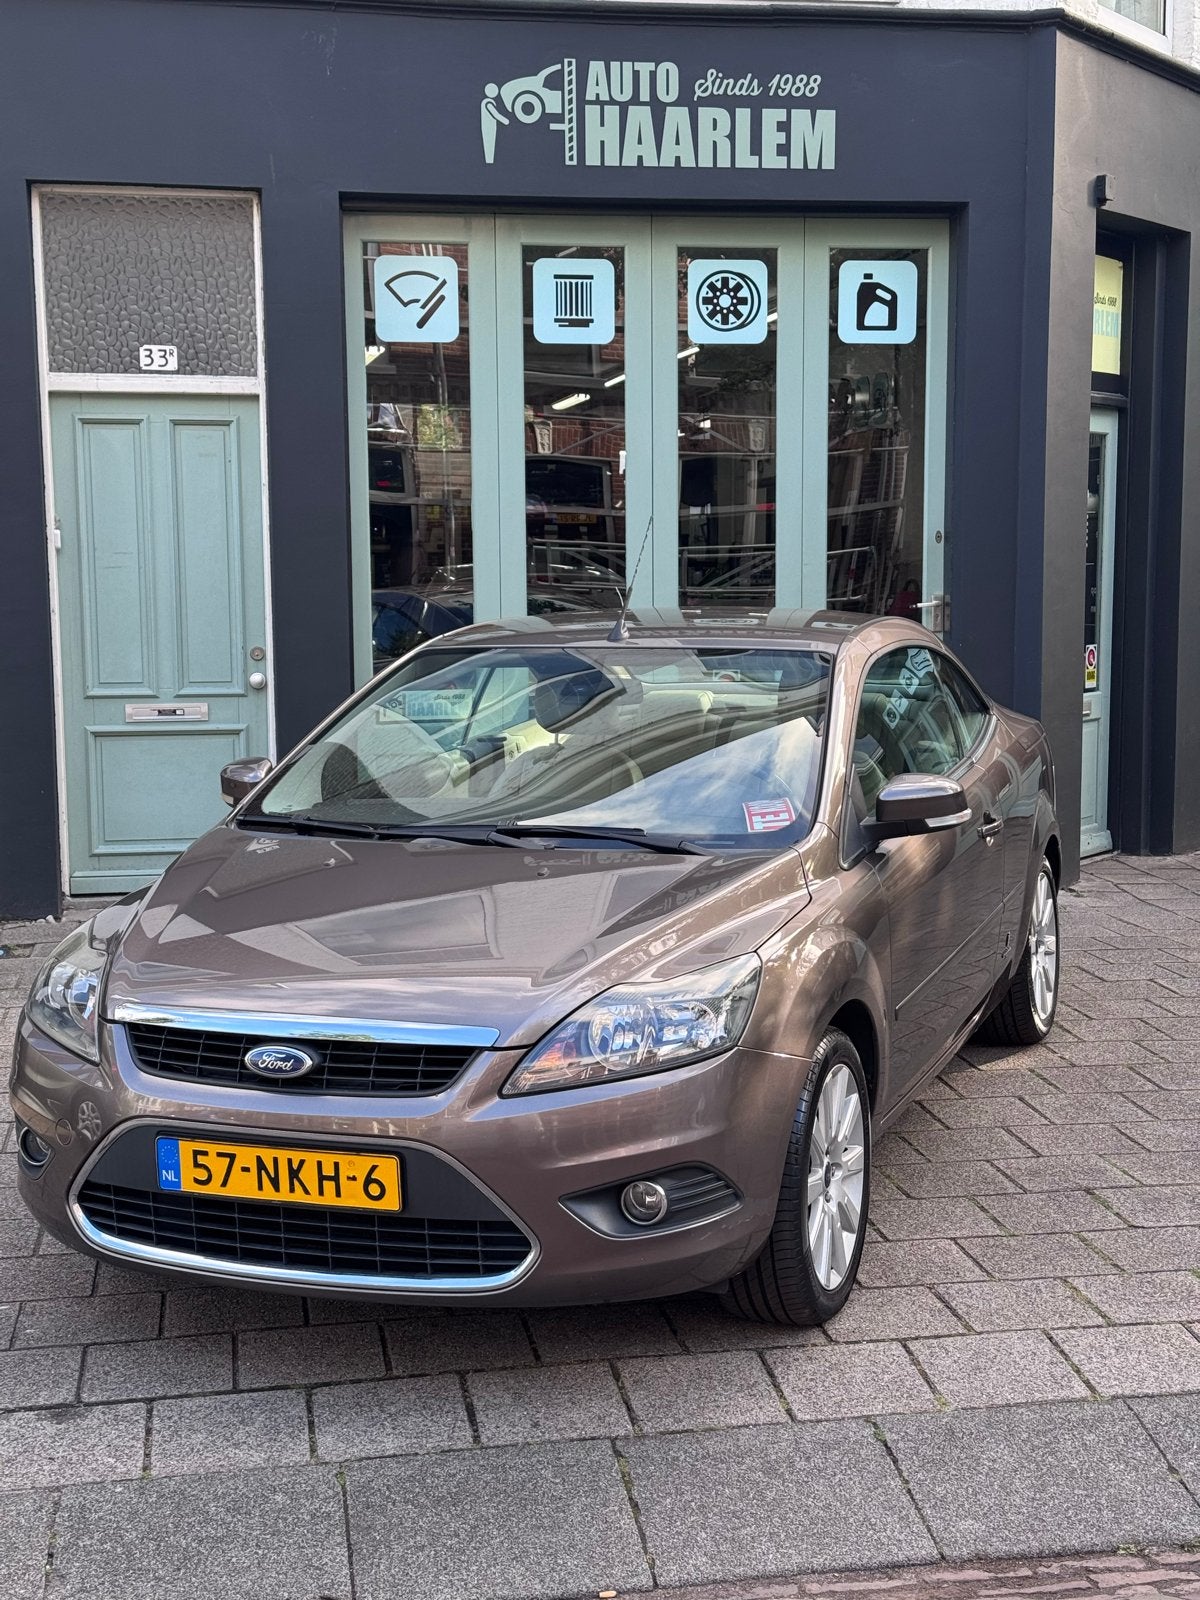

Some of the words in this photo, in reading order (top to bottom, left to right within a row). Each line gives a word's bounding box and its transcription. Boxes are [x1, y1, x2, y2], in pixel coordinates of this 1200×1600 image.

[585, 60, 679, 103] AUTO
[693, 68, 764, 102] Sinds
[768, 73, 822, 98] 1988
[584, 104, 836, 170] HAARLEM
[258, 1051, 294, 1071] Ford
[162, 1169, 179, 1183] NL
[192, 1148, 387, 1202] 57-NKH-6
